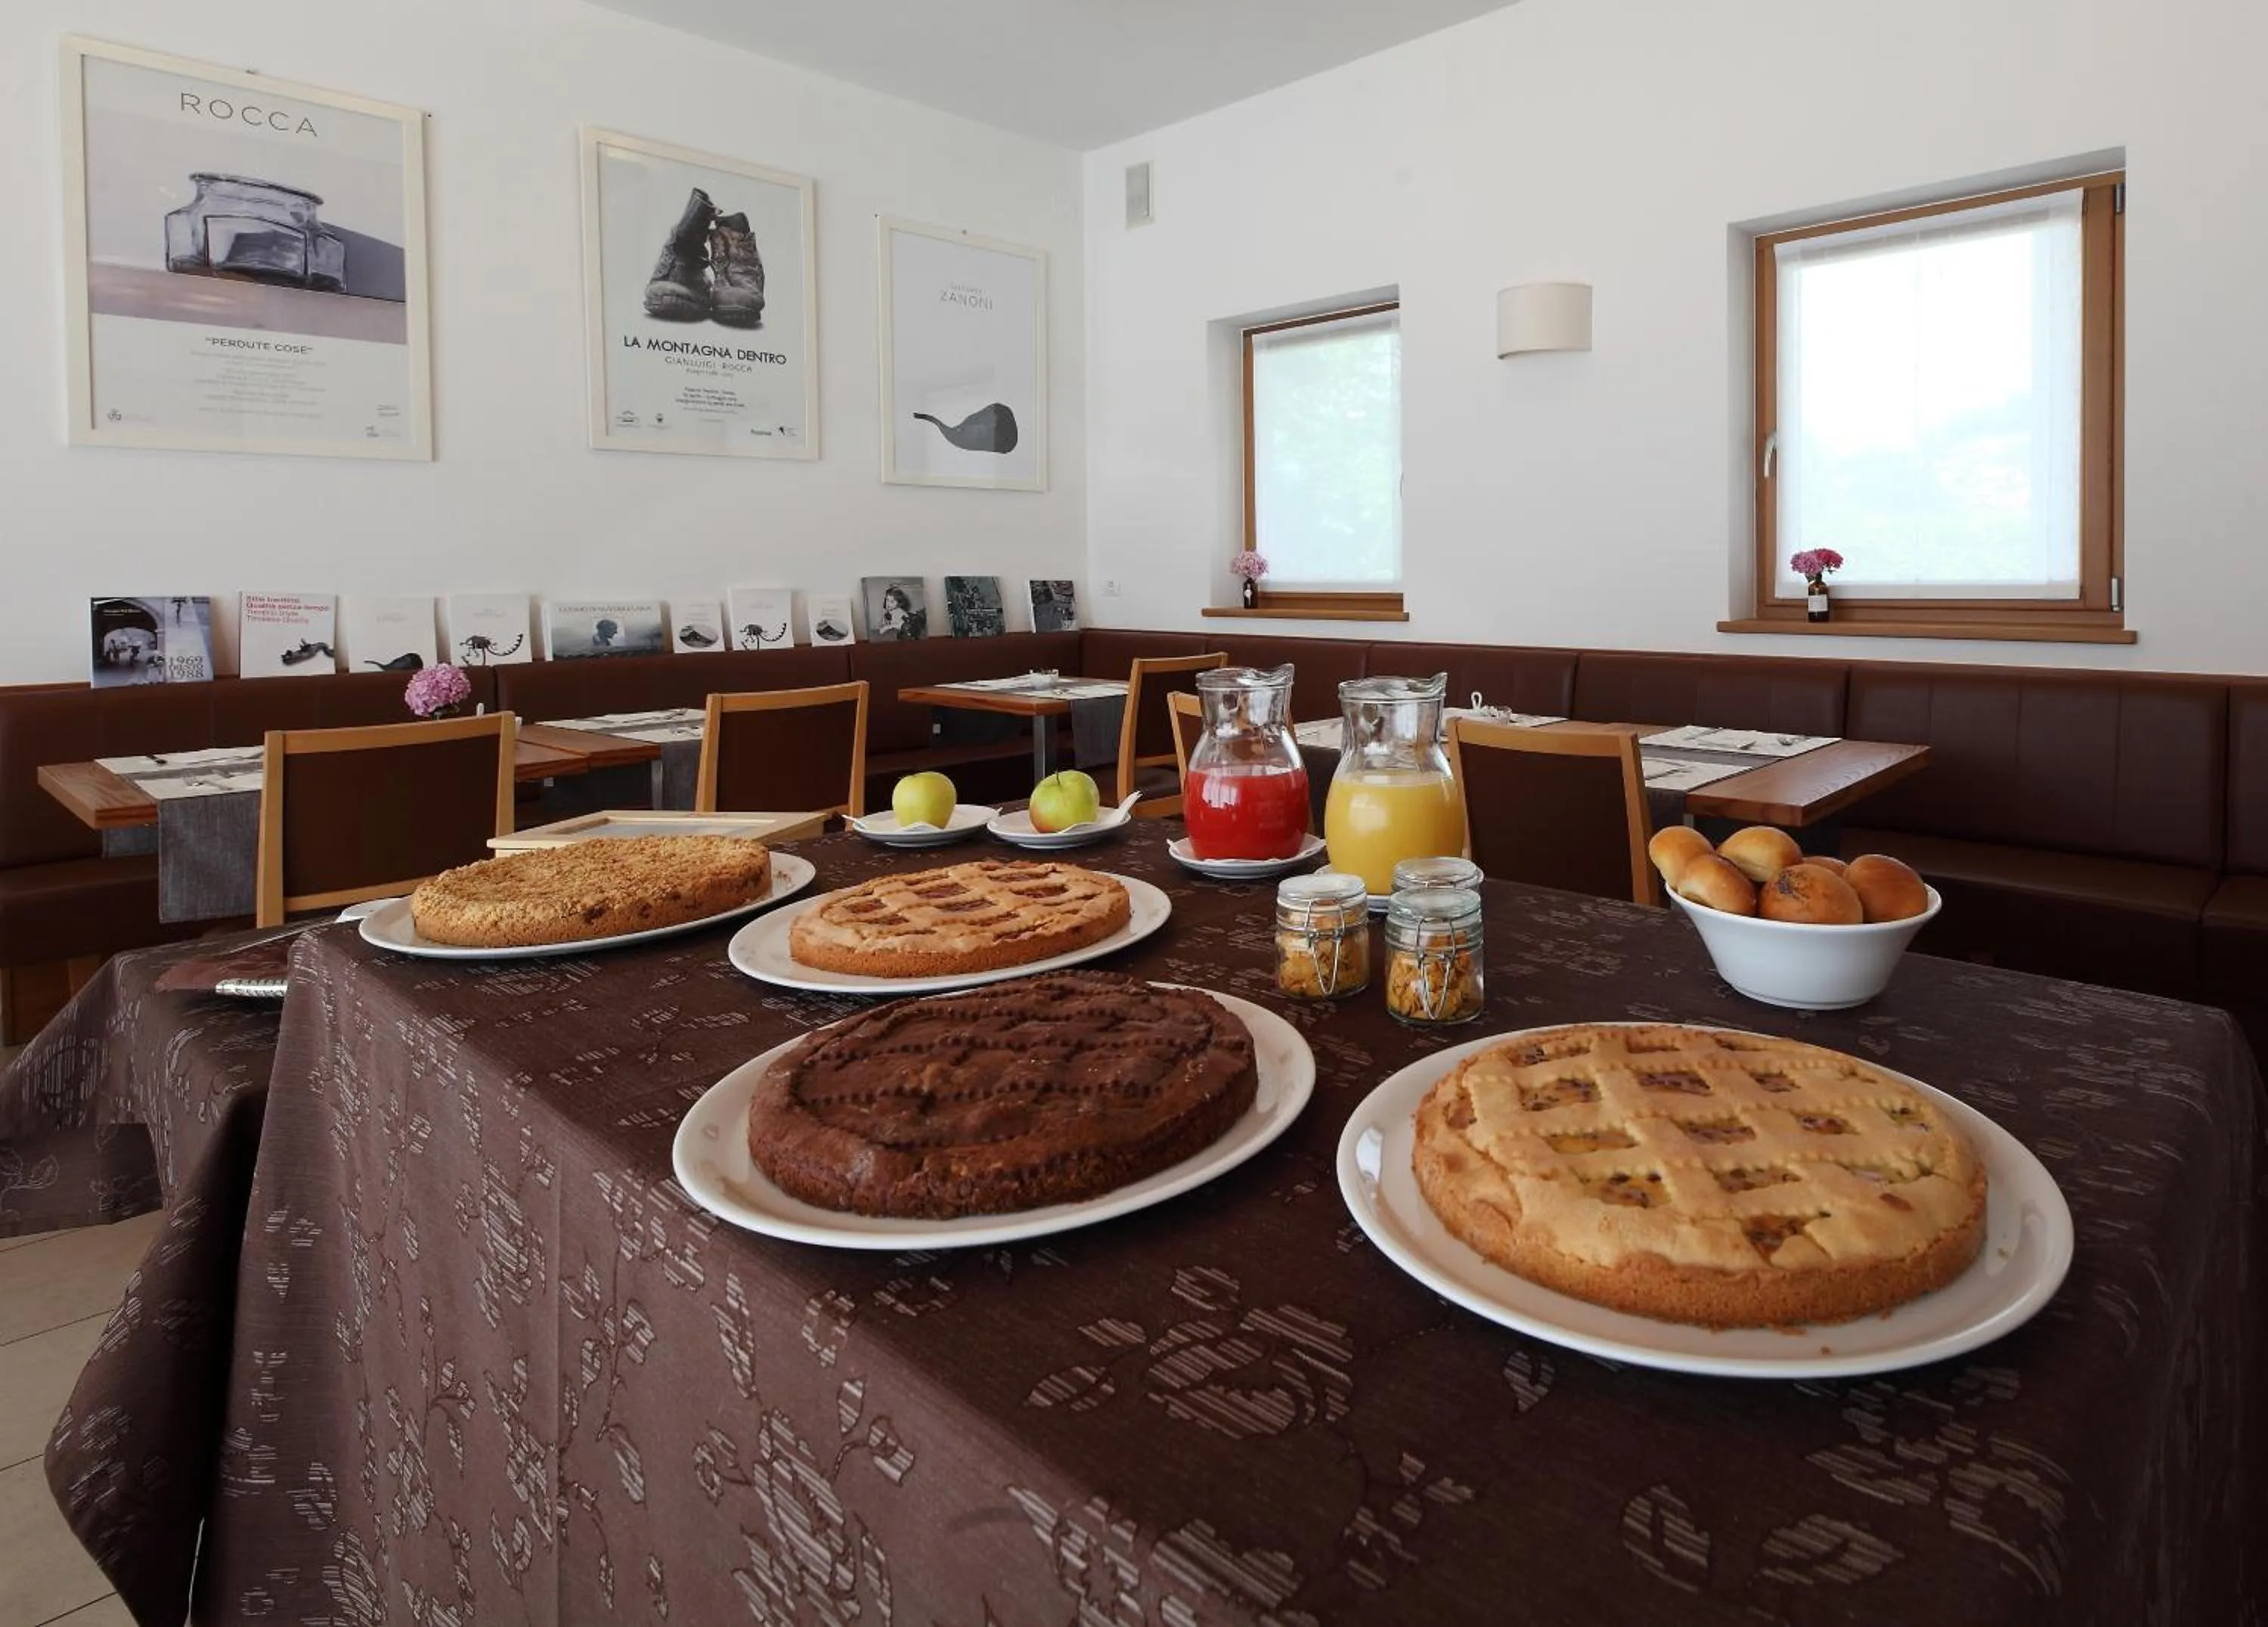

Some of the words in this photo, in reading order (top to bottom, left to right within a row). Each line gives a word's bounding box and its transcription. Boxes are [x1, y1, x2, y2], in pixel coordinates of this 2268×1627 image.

[180, 91, 318, 137] ROCCA
[940, 290, 993, 310] ZANONI
[205, 336, 271, 351] "PERDUTE
[274, 342, 314, 355] COSE"
[623, 335, 641, 349] LA
[646, 338, 733, 360] MONTAGNA
[737, 349, 787, 365] DENTRO
[665, 355, 716, 370] GIANLUIGI
[722, 361, 753, 373] ROCCA
